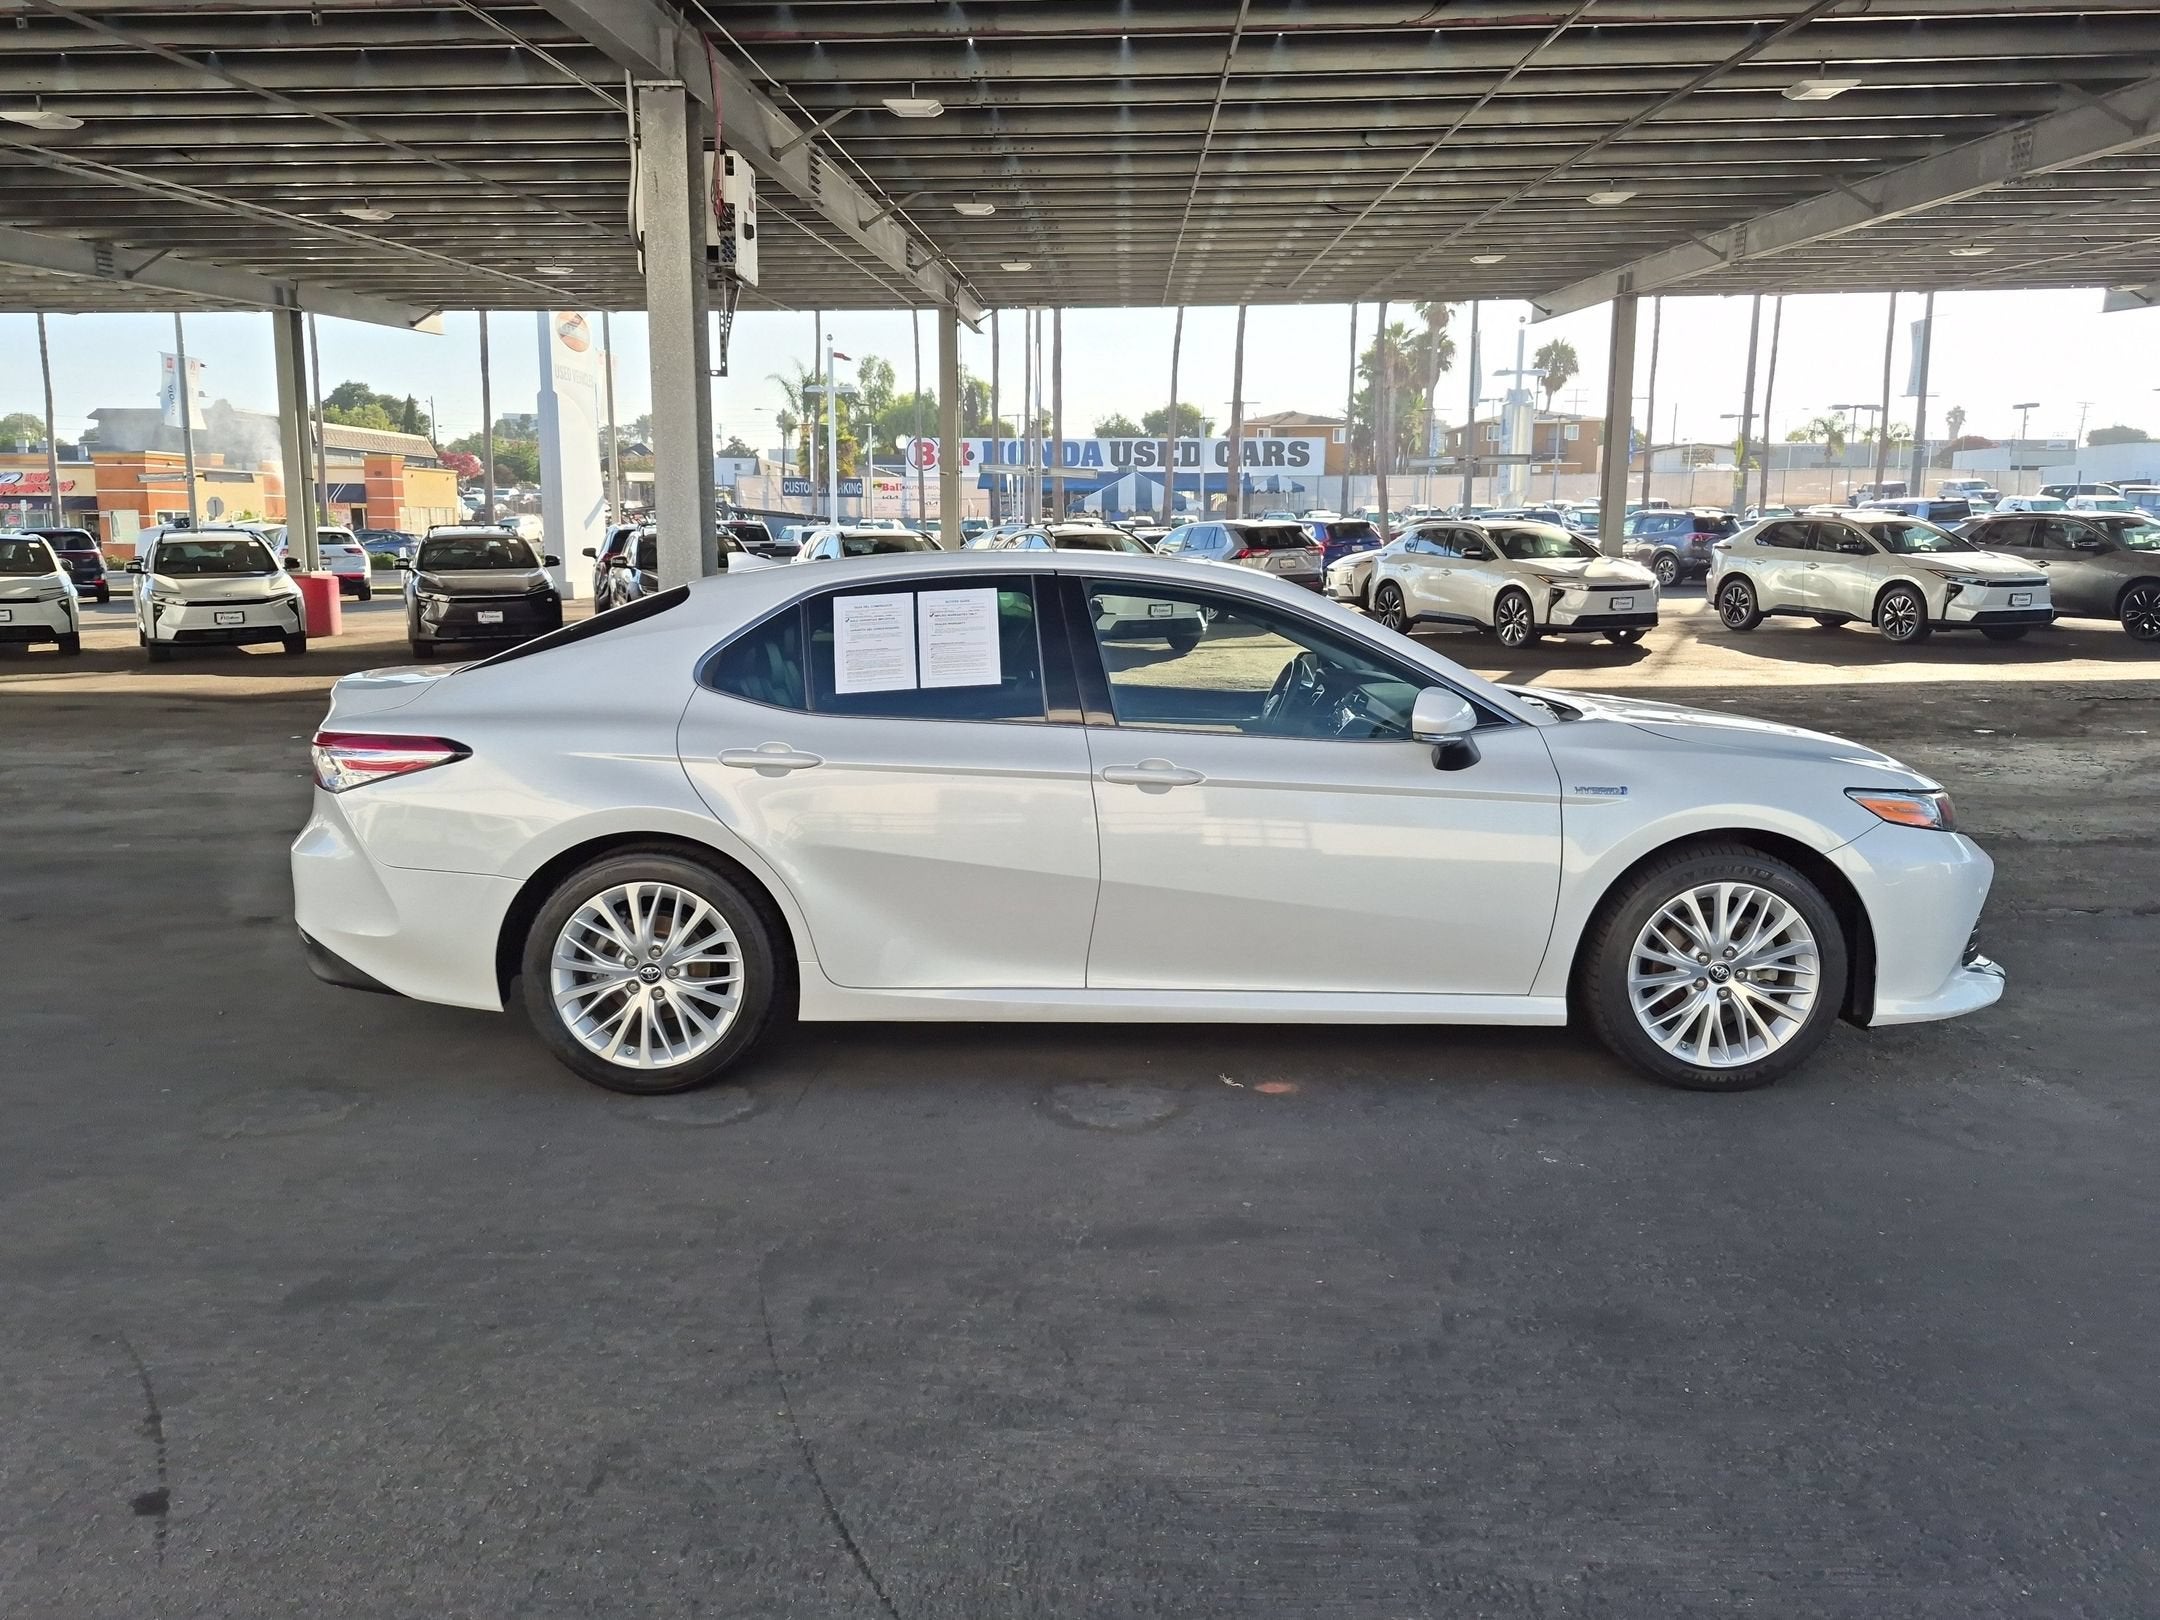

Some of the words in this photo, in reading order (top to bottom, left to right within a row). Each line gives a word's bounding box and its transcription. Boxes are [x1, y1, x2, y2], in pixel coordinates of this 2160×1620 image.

[982, 441, 1104, 467] HONDA
[1109, 441, 1200, 467] USED
[1215, 440, 1310, 467] CARS
[783, 481, 827, 494] CUSTOR
[829, 482, 863, 495] RKING
